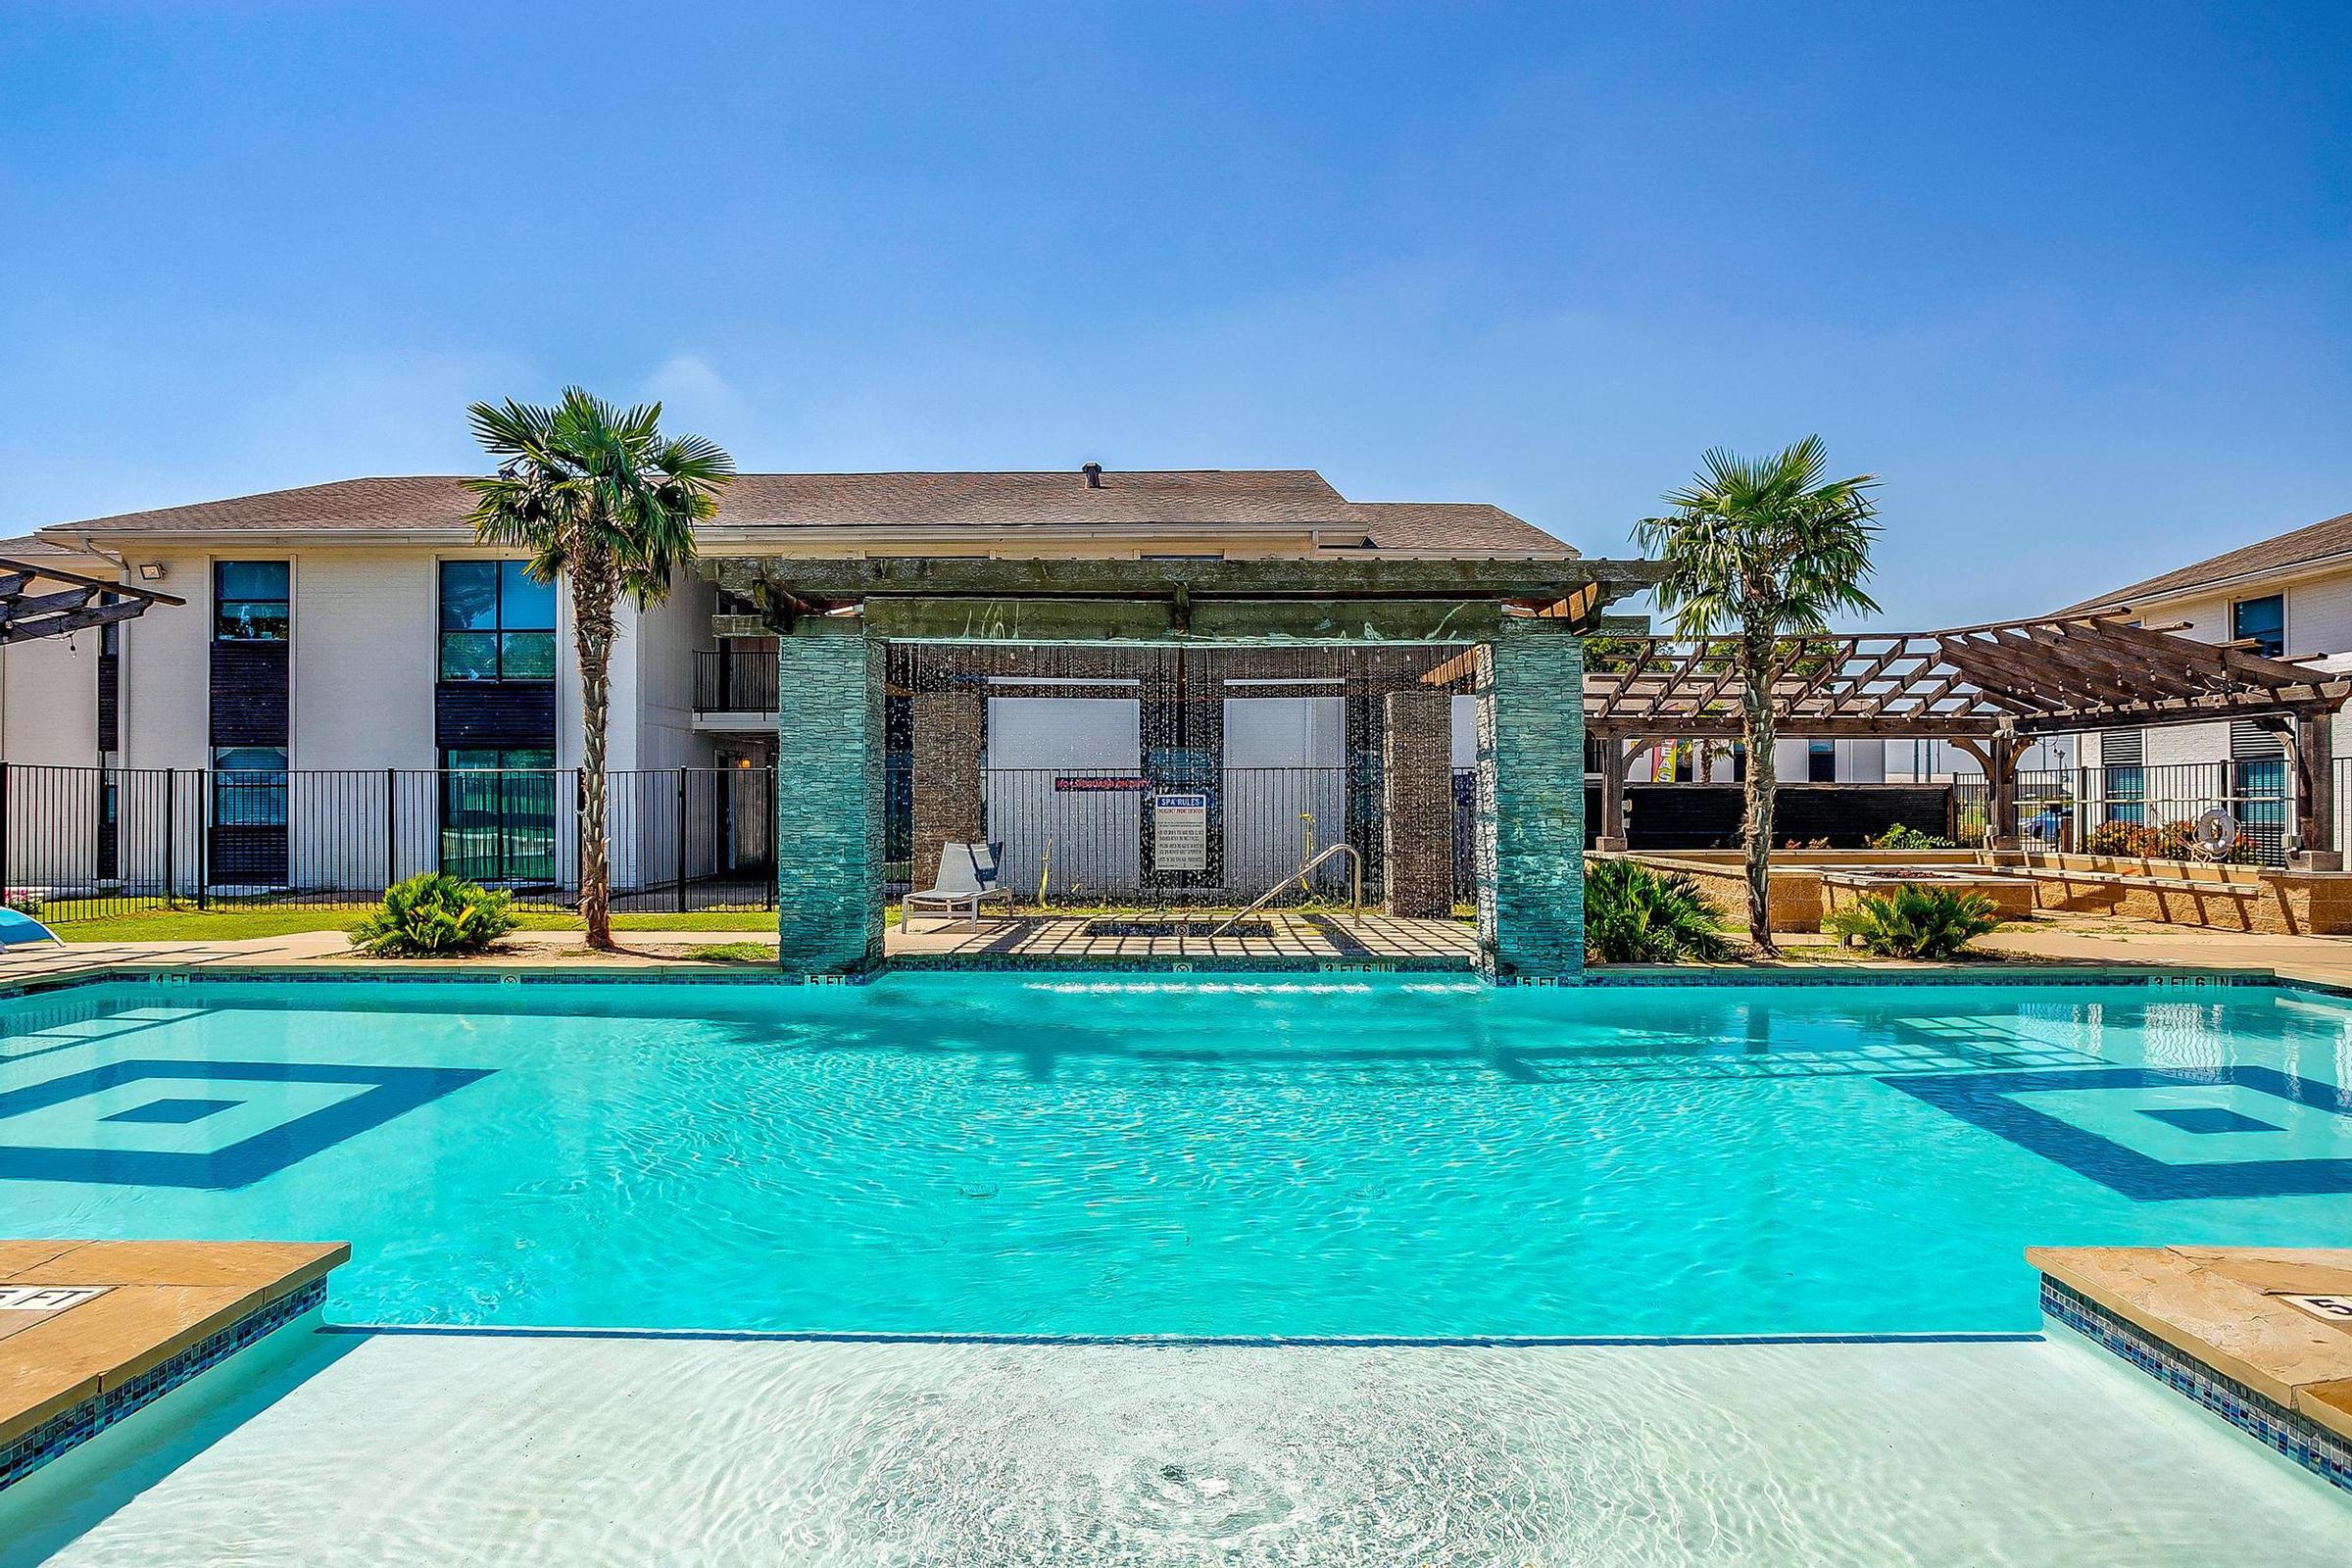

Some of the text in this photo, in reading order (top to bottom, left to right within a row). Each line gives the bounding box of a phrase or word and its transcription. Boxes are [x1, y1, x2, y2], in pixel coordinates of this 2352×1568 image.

[1056, 778, 1069, 788] NO
[1161, 798, 1200, 807] SPA RULES
[826, 976, 843, 986] FT
[1539, 977, 1556, 987] FT
[2171, 977, 2187, 986] FT
[2214, 976, 2229, 987] IN
[12, 1290, 95, 1306] FT
